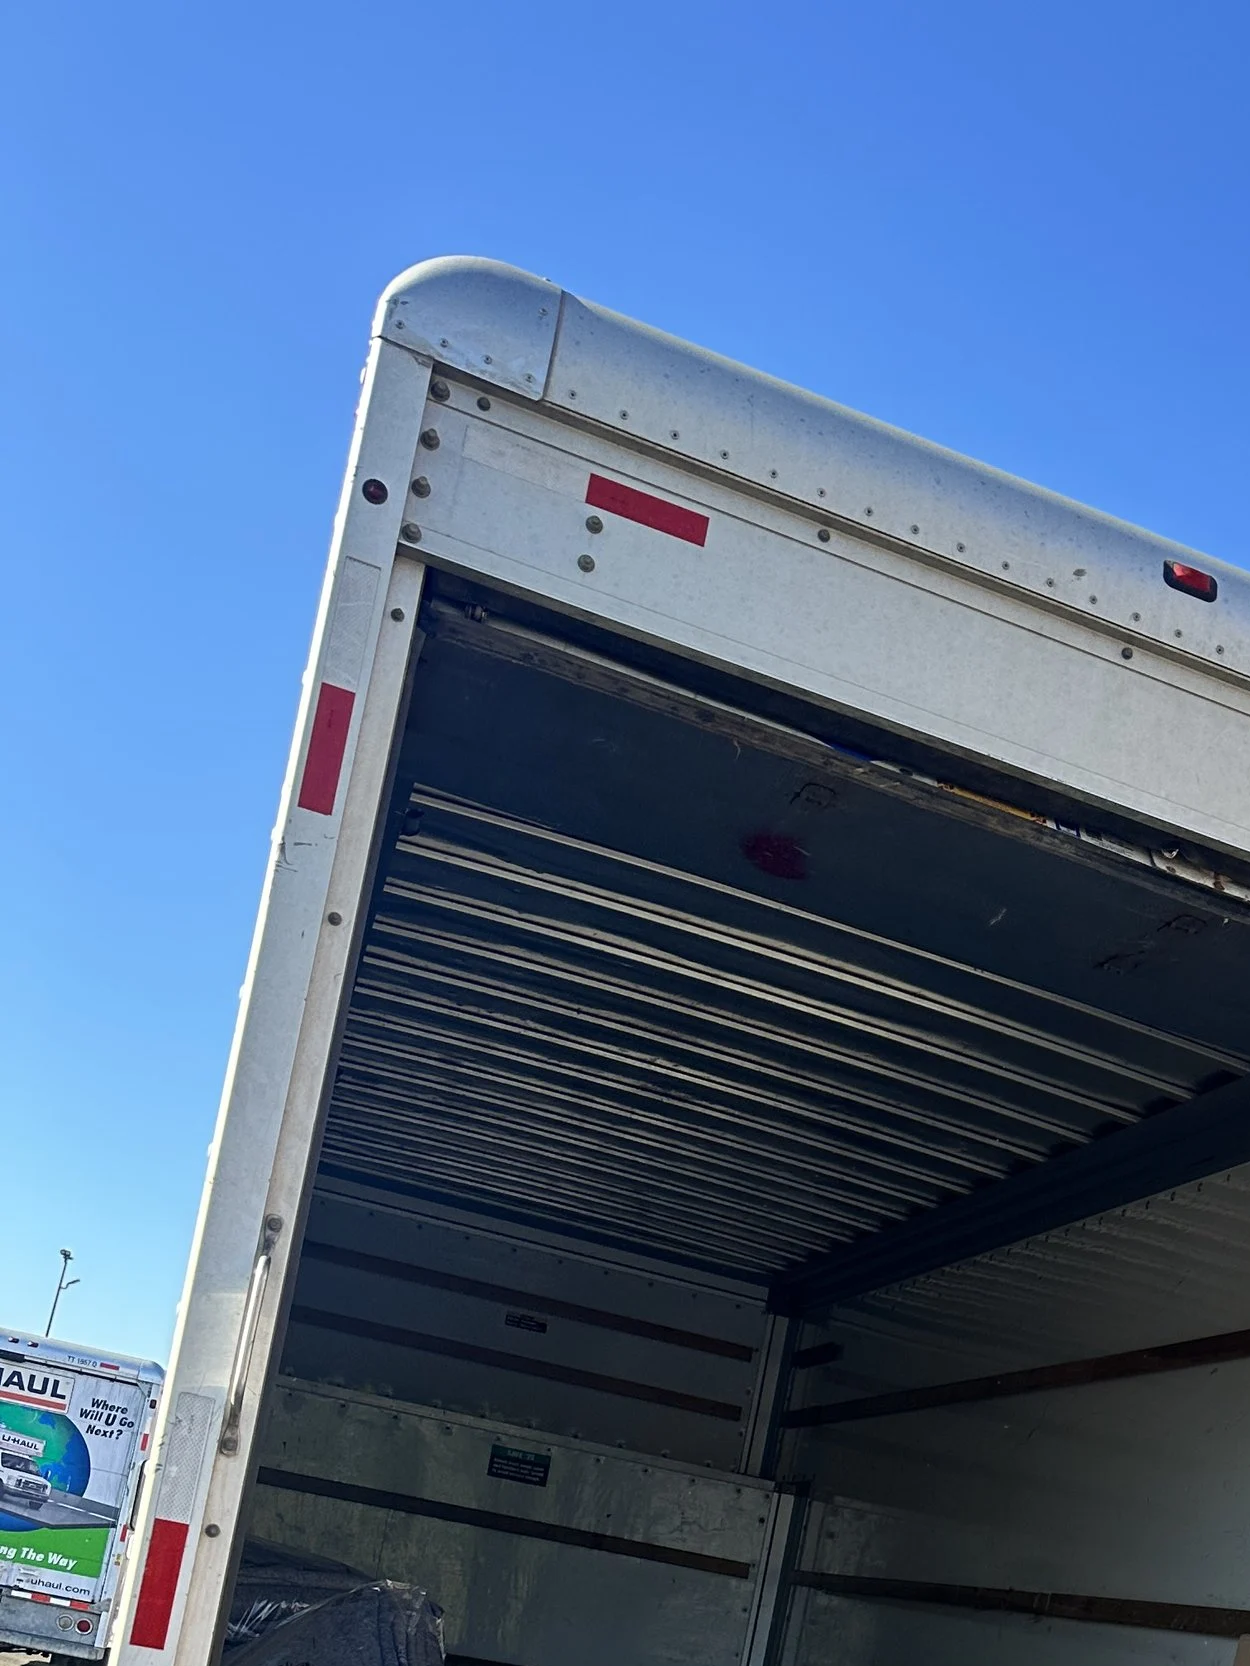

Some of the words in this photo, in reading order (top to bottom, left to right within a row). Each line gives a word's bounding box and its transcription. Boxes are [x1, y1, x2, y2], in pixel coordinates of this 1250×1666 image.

[0, 1368, 66, 1400] AUL
[91, 1398, 128, 1415] Where
[79, 1407, 103, 1422] Will
[104, 1413, 117, 1427] U
[119, 1416, 134, 1429] Go
[86, 1424, 123, 1440] Next?
[20, 1547, 44, 1562] The
[47, 1552, 77, 1570] Way
[31, 1577, 90, 1596] uhaul.com
